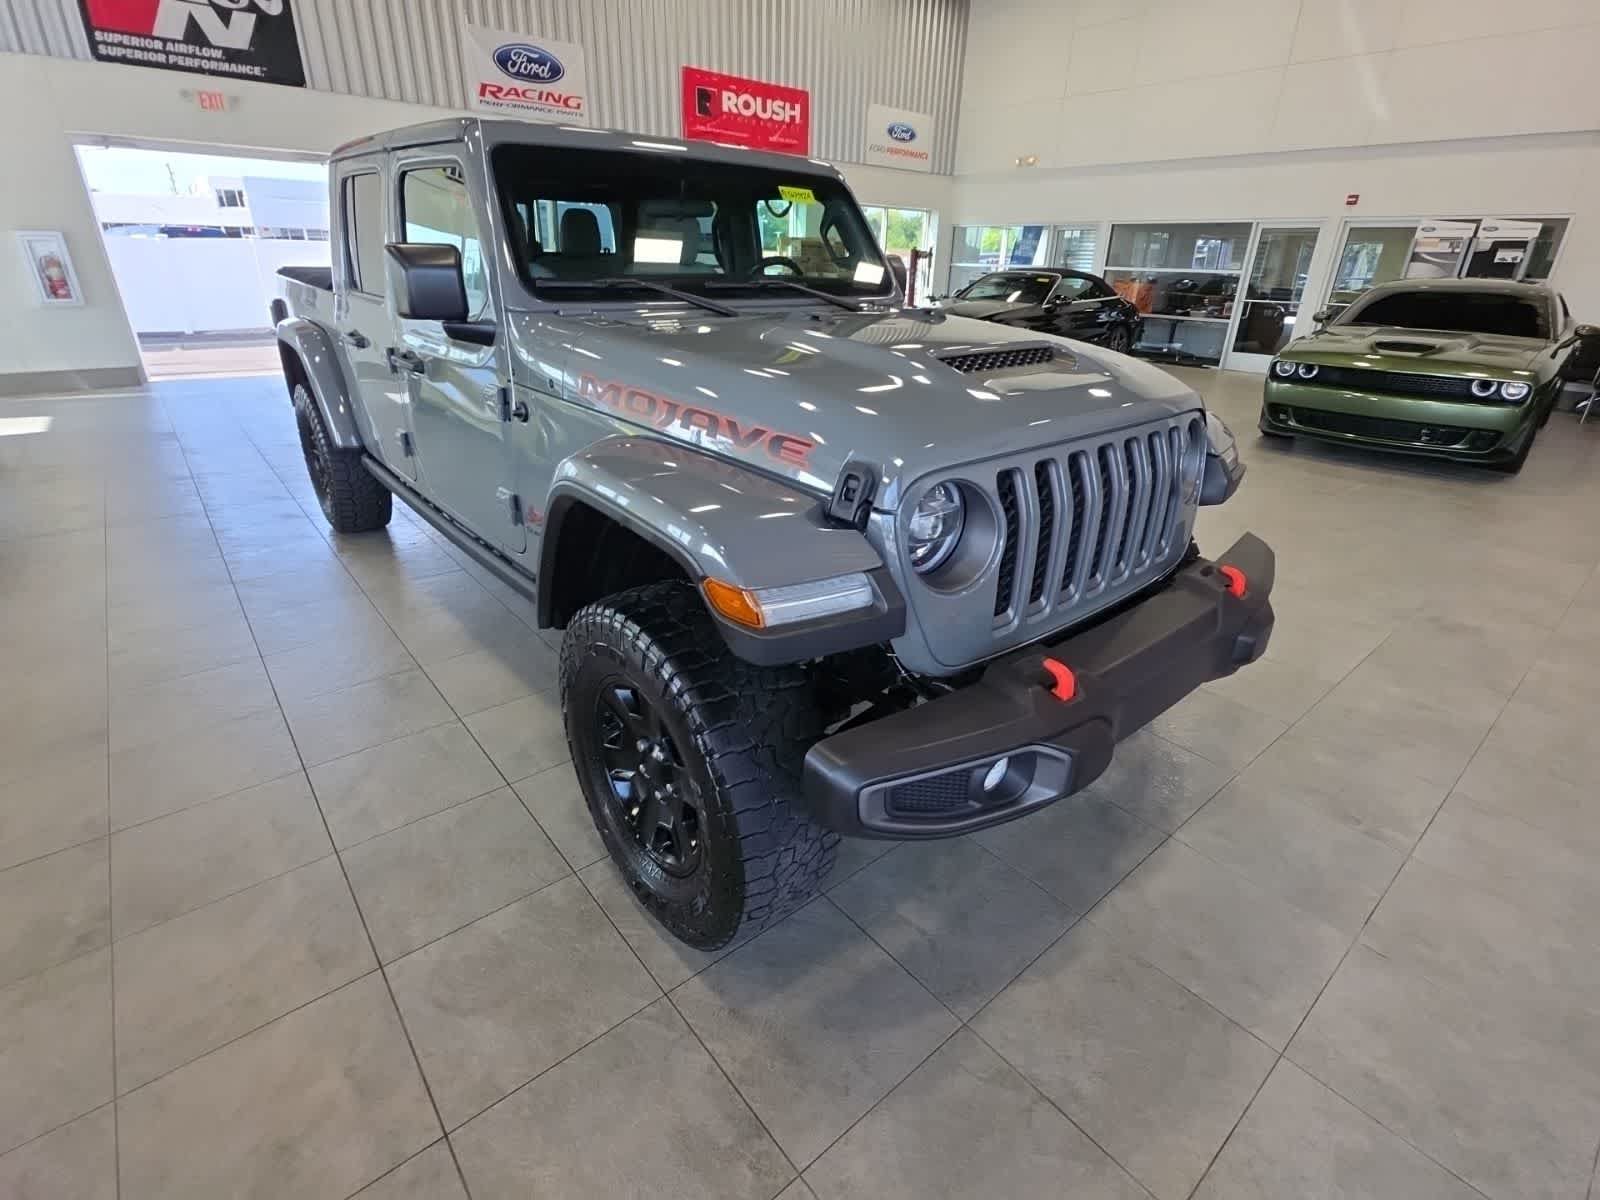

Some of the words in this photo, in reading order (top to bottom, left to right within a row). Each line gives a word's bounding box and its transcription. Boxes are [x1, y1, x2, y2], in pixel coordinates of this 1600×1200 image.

[94, 30, 164, 50] SUPERIOR
[165, 39, 226, 60] AIRFLOW.
[97, 44, 168, 64] SUPERIOR
[507, 48, 552, 78] Ford
[198, 91, 226, 111] EXIT
[478, 82, 584, 110] RACING
[721, 90, 801, 124] ROUSH
[578, 374, 816, 470] MOJAVE
